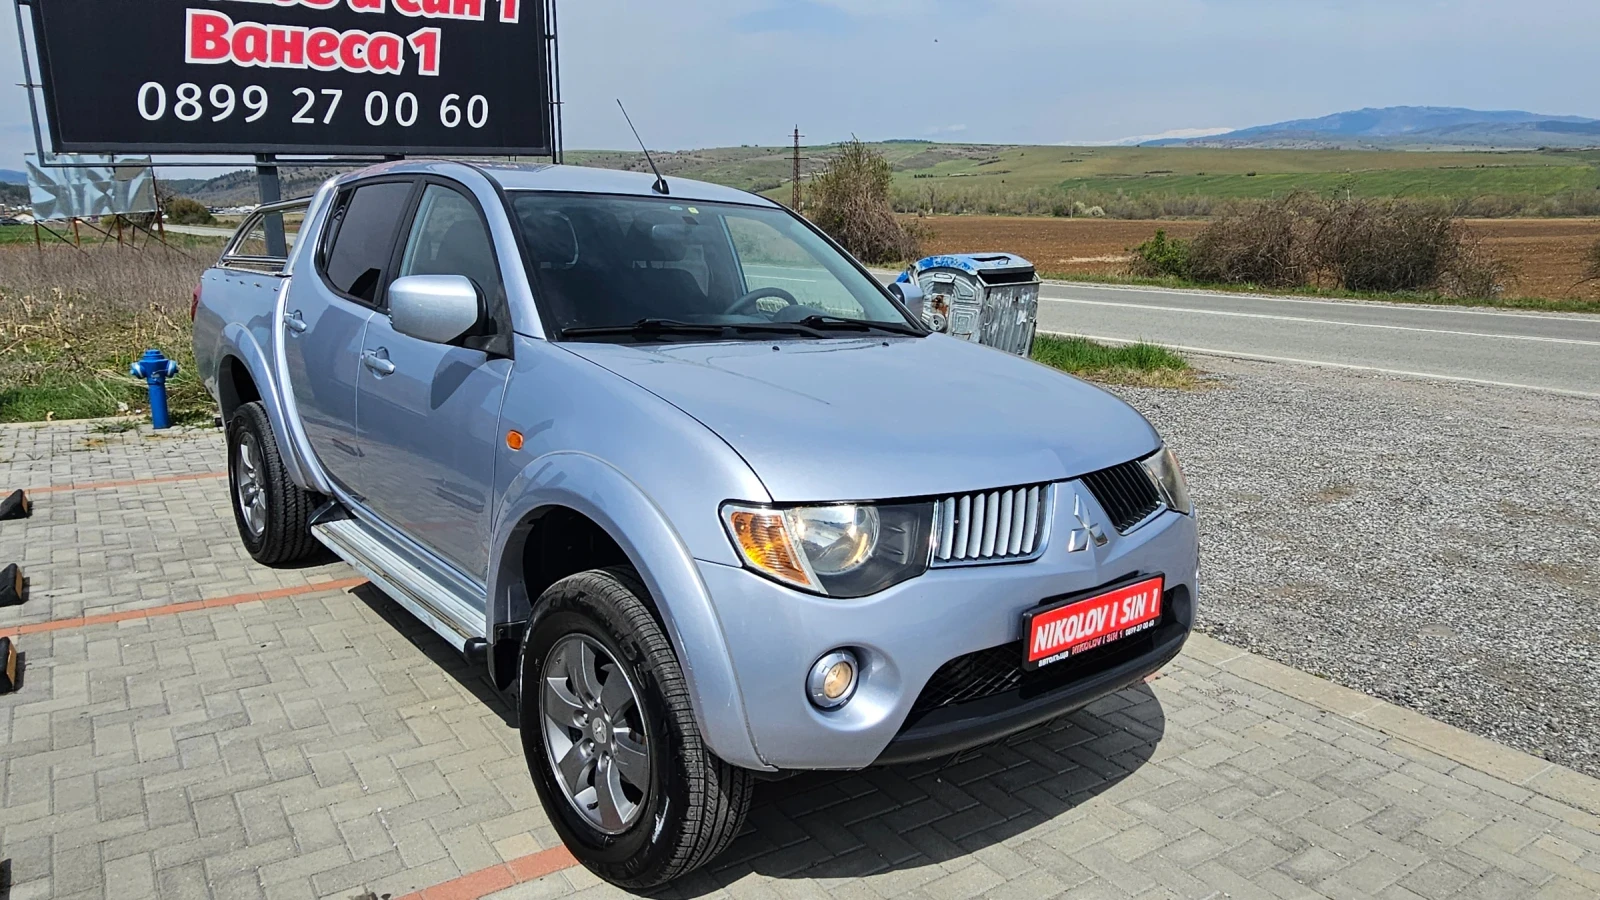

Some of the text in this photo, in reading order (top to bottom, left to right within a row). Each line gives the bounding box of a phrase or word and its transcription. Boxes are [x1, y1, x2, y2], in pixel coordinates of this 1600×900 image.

[185, 7, 442, 76] Ванеса 1
[137, 81, 489, 129] 0899 27 00 60
[1033, 605, 1109, 653] NIKOLOV
[1120, 592, 1148, 623] SIN
[1151, 588, 1159, 613] 1
